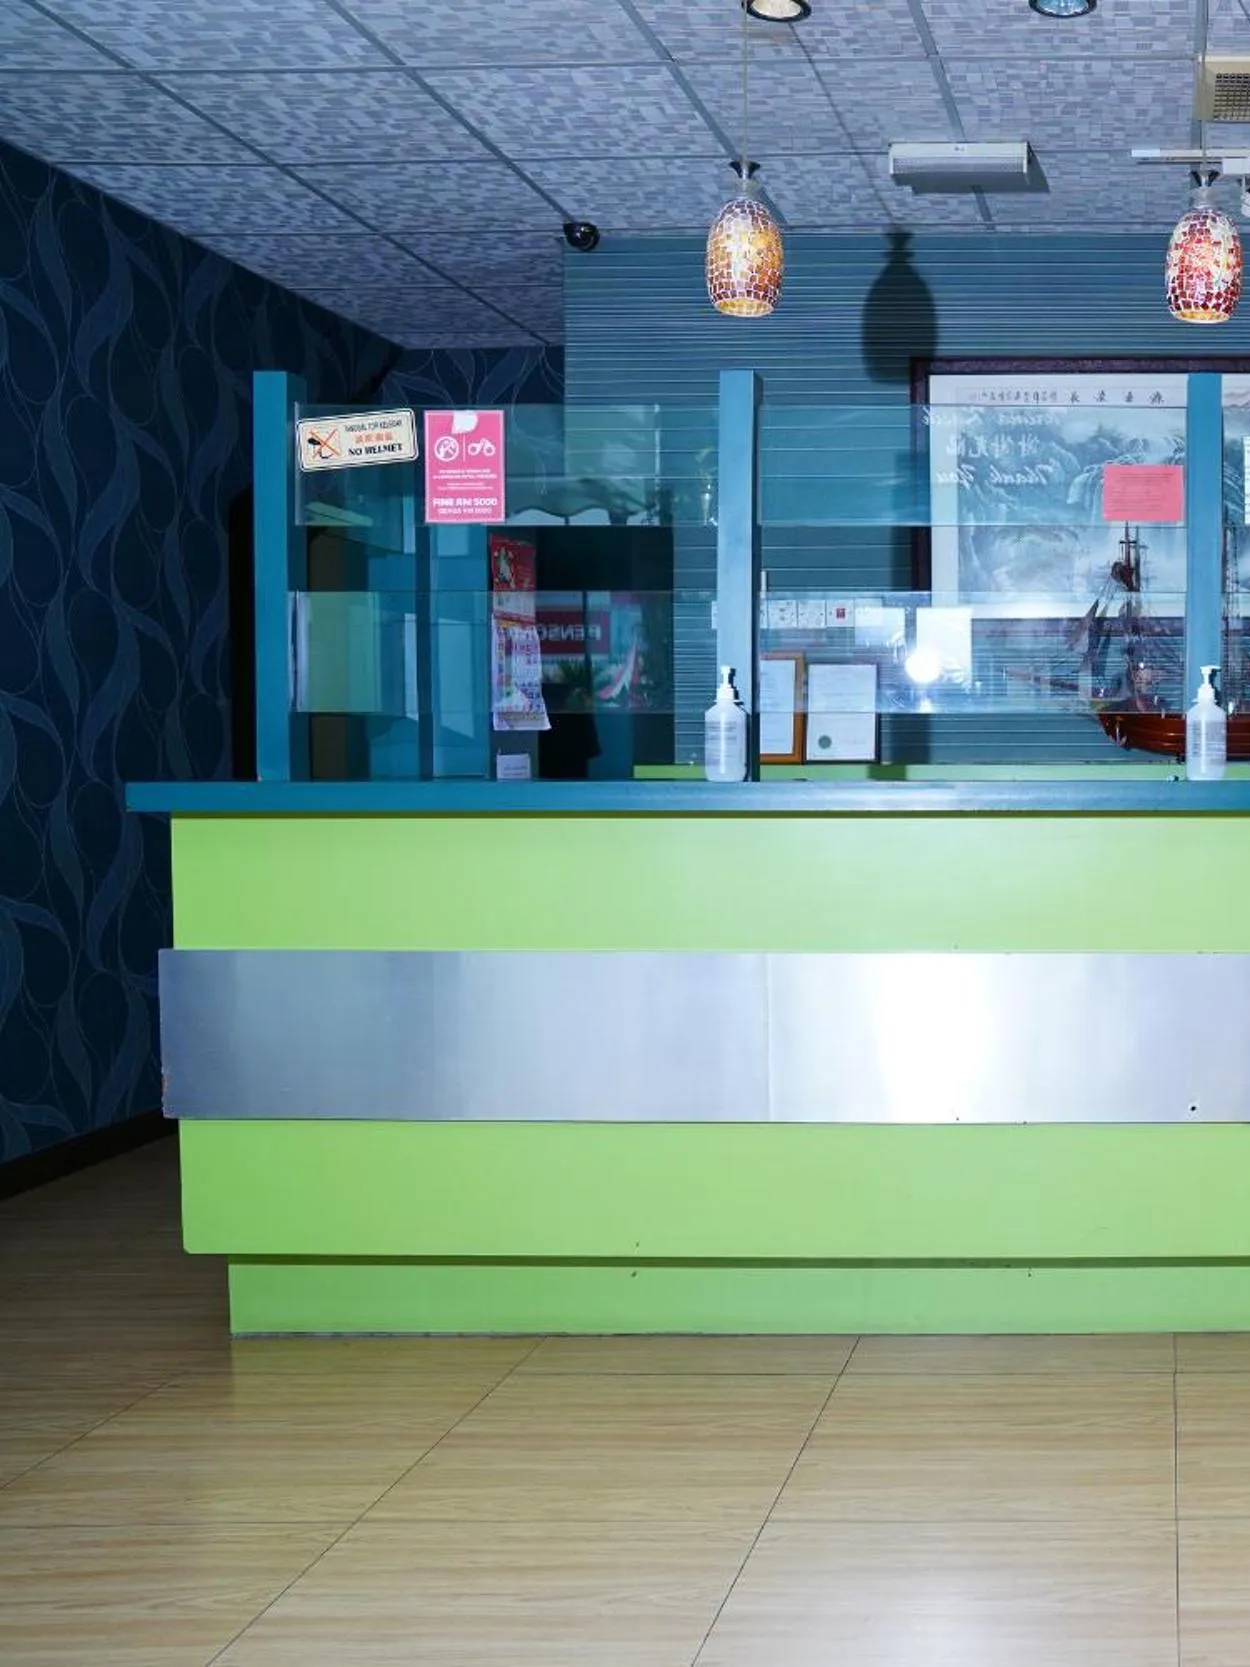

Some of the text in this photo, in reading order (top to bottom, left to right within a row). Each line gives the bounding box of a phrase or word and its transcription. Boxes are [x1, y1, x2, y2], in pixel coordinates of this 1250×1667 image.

[348, 443, 402, 456] NO HELMET
[473, 497, 498, 507] 5000
